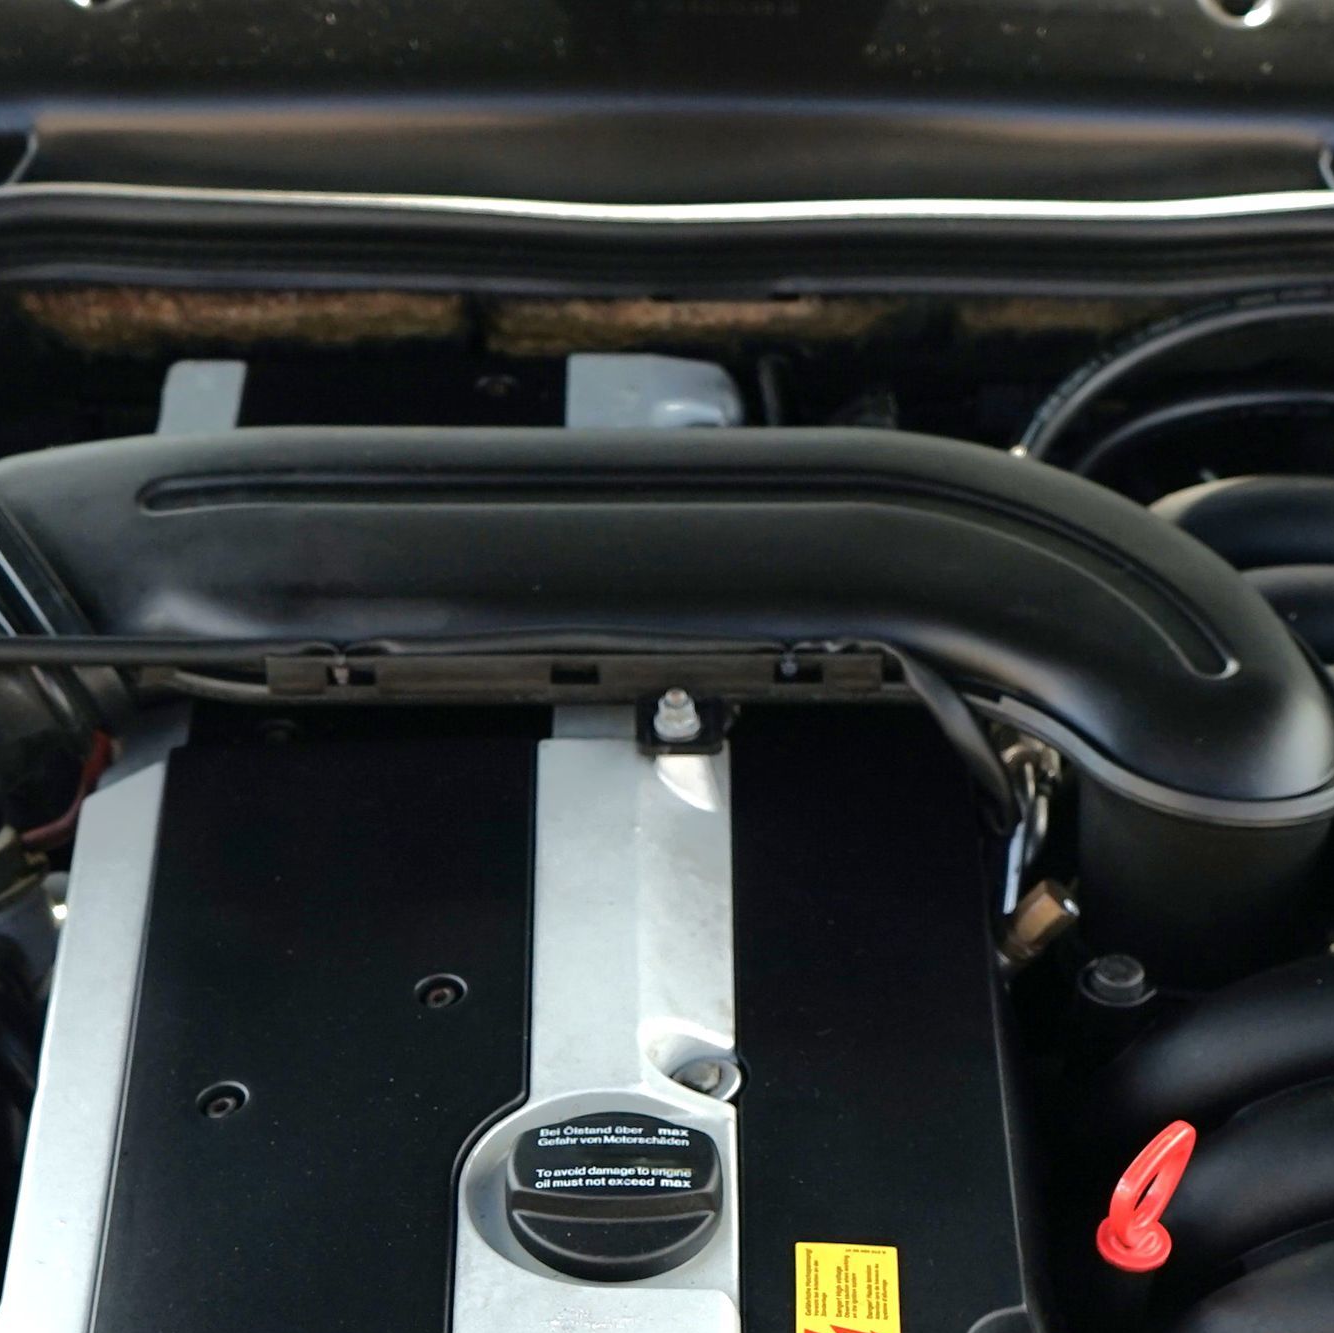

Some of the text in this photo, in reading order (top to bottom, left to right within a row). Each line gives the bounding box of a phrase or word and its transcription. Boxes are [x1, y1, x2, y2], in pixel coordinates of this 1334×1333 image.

[539, 1128, 561, 1137] Bei
[657, 1127, 689, 1137] max
[537, 1135, 690, 1147] Gefahr von Motorschäden
[535, 1166, 692, 1179] To avoid damage to engine
[534, 1177, 692, 1189] oil must not exceed max
